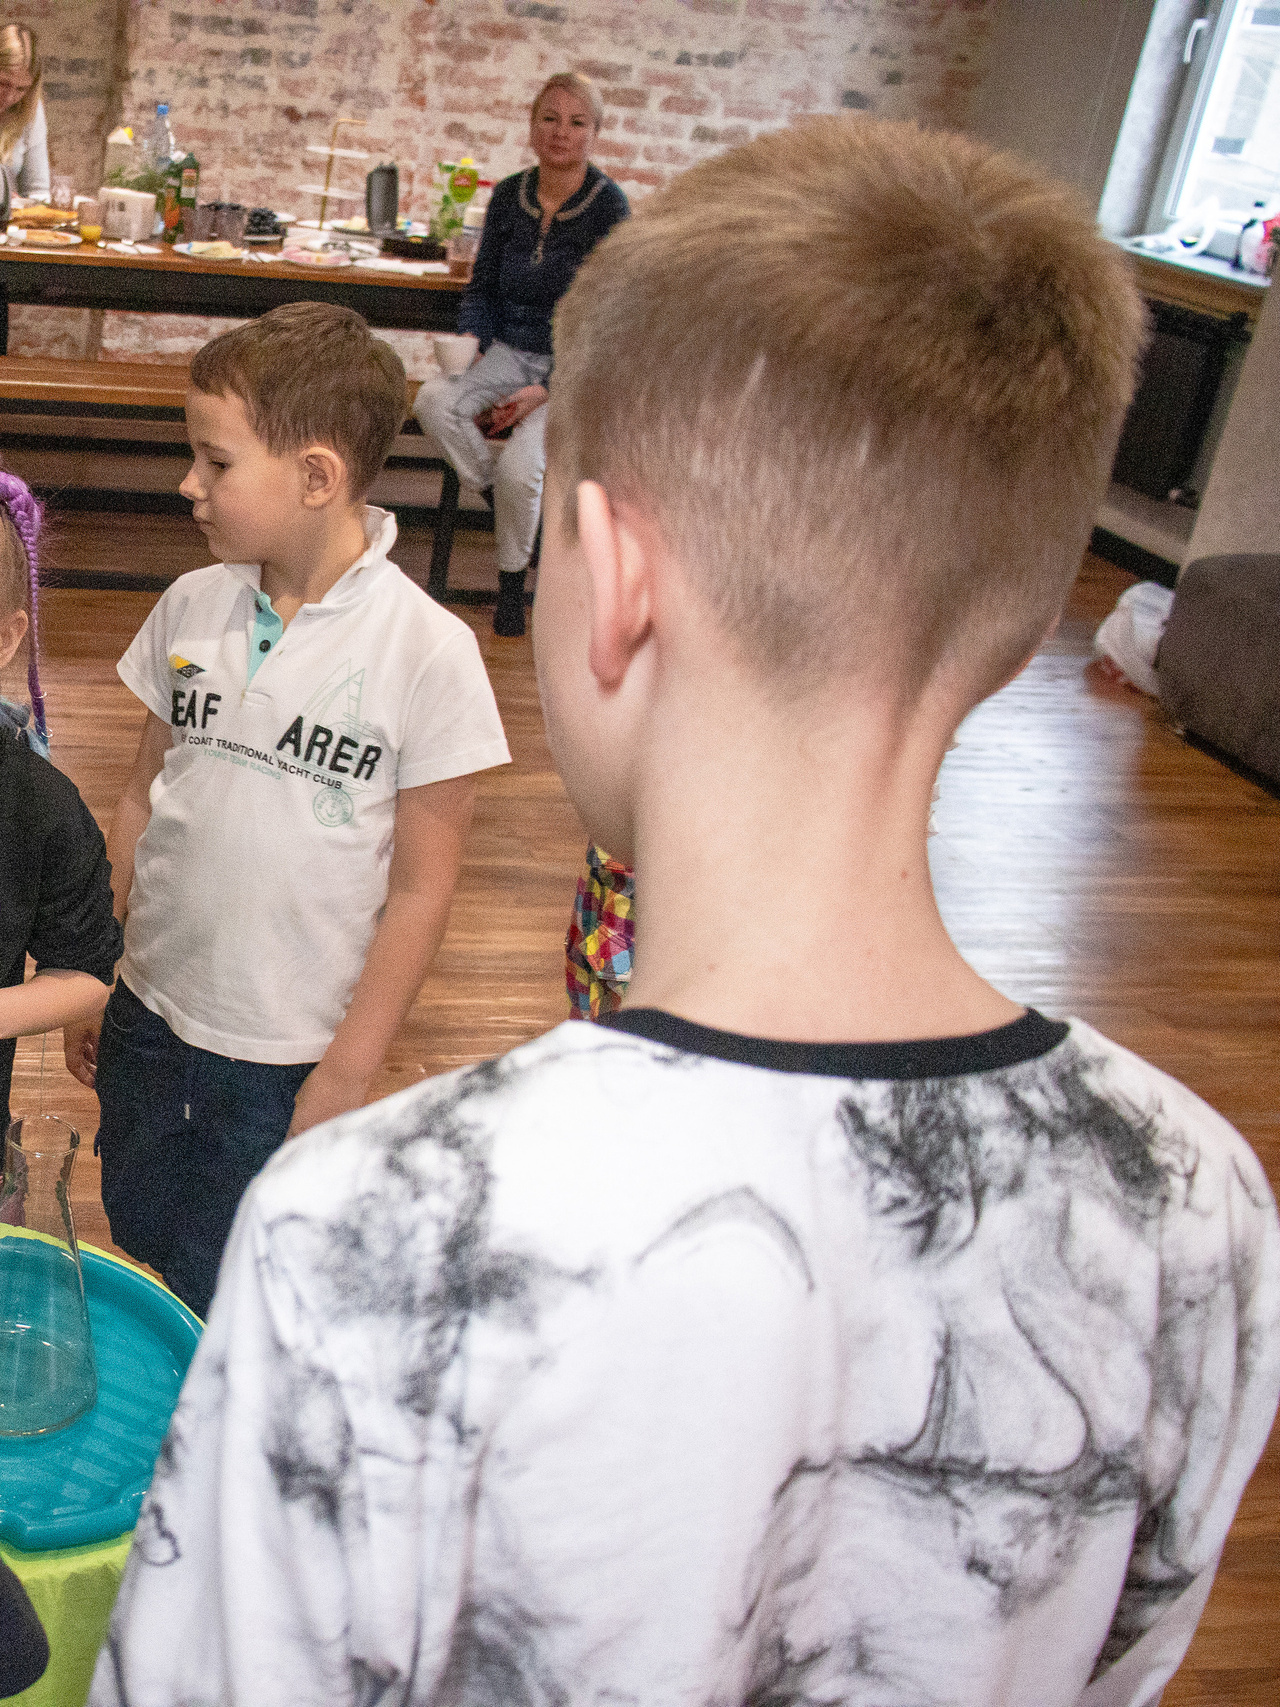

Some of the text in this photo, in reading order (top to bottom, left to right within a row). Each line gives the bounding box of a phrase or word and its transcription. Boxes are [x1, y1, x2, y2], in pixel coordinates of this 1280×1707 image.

[216, 738, 274, 765] TRADITIONAL
[277, 759, 311, 779] YACHT
[313, 773, 343, 790] CLUB
[276, 715, 382, 781] ARER
